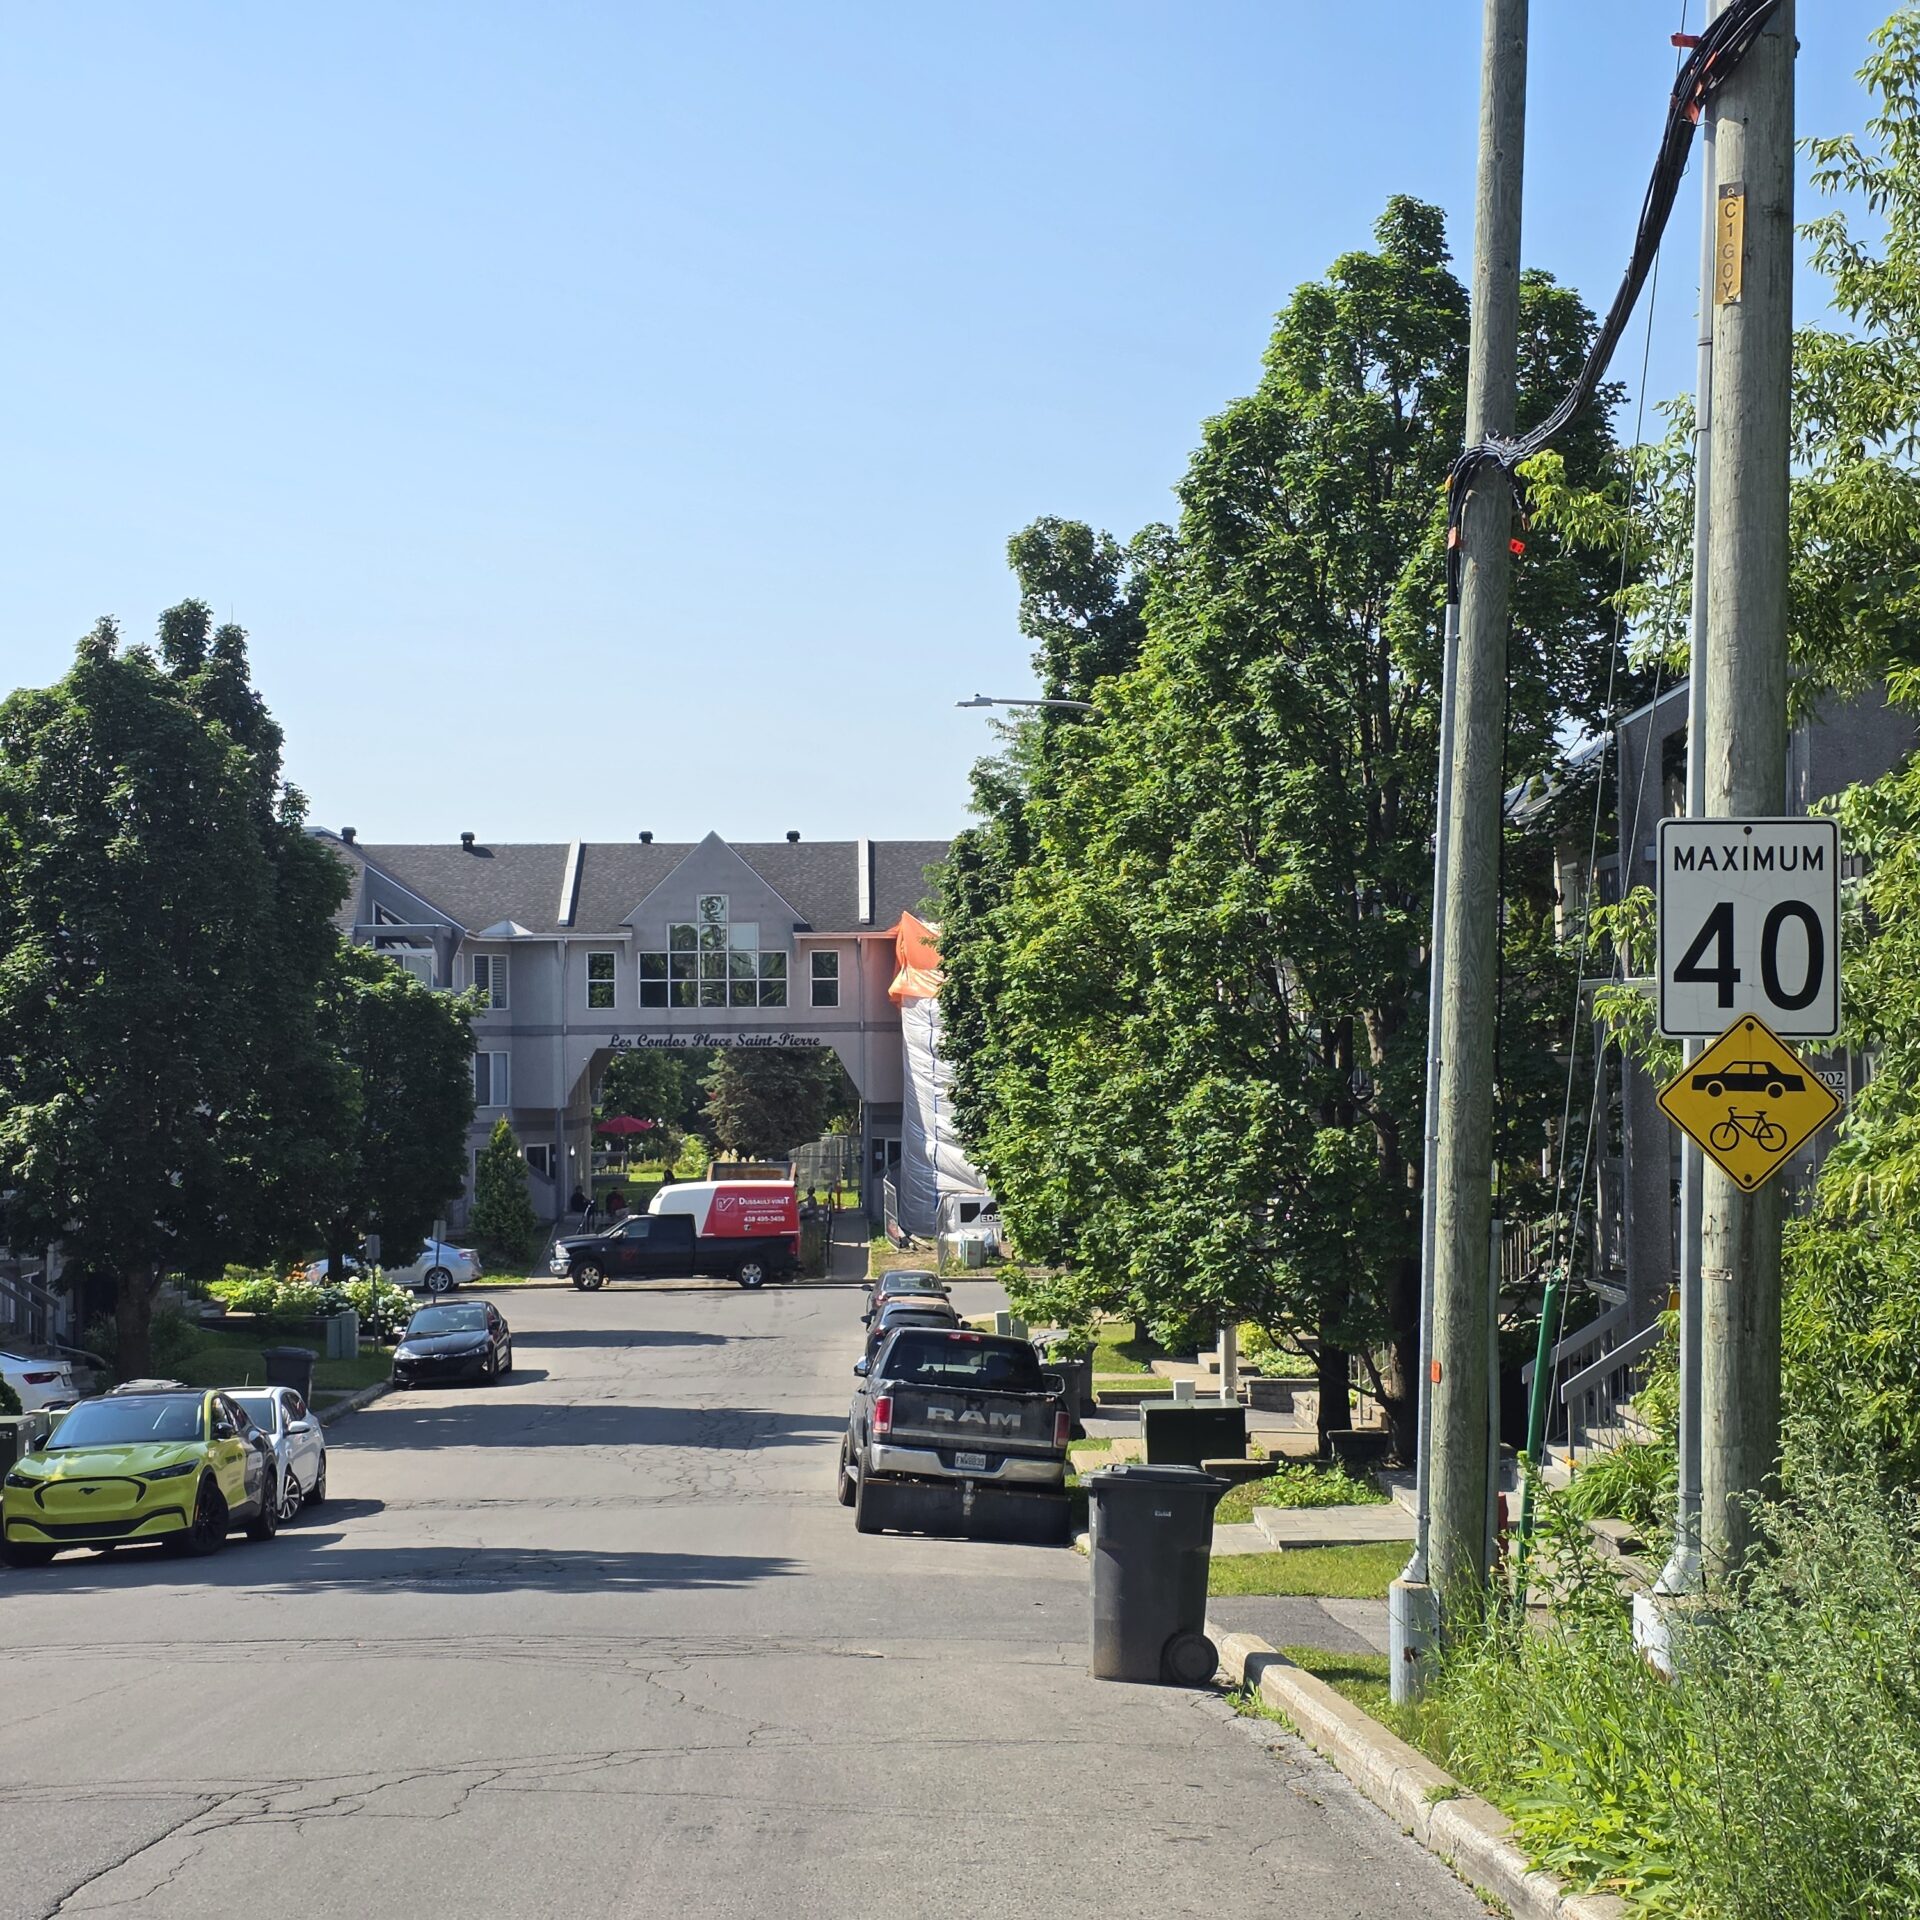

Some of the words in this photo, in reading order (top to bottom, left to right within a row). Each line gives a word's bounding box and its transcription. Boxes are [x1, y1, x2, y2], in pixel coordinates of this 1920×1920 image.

[1674, 846, 1824, 871] MAXIMUM
[1673, 900, 1825, 1011] 40
[608, 1033, 632, 1048] Les
[637, 1034, 687, 1047] Condos
[691, 1034, 733, 1047] Place
[736, 1032, 821, 1047] Saint-Pierre
[927, 1406, 1022, 1427] RAM
